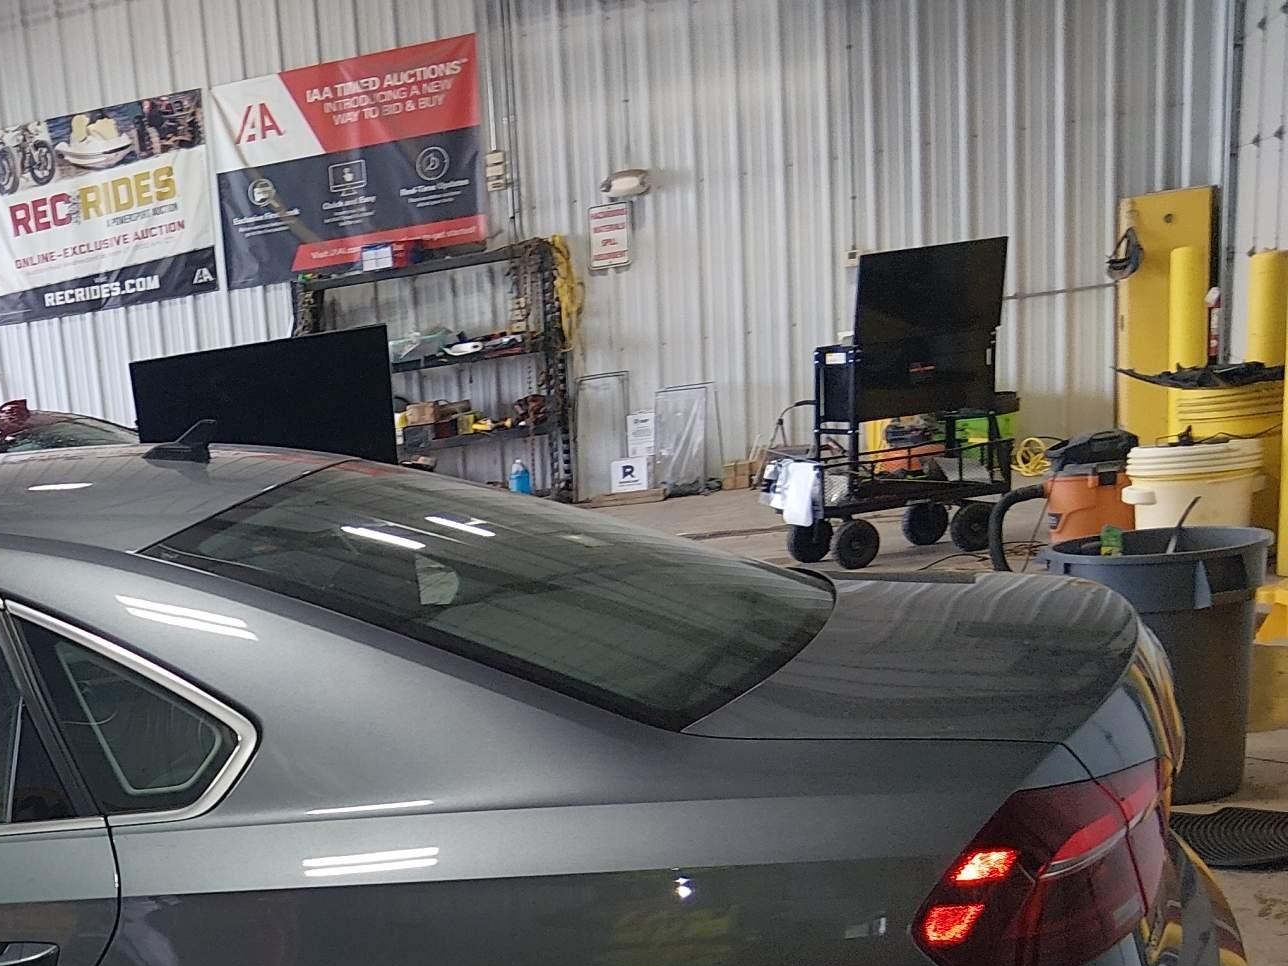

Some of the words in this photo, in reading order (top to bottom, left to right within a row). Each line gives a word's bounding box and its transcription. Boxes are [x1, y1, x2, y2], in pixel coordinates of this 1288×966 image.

[306, 87, 333, 103] IAA
[334, 77, 380, 97] TIMED
[324, 87, 408, 113] INTRODUCING
[410, 85, 421, 97] A
[422, 77, 455, 94] NEW
[332, 109, 361, 126] WAY
[362, 107, 379, 120] TO
[382, 103, 403, 116] BID
[405, 100, 417, 112] &
[418, 94, 447, 109] BUY
[9, 192, 74, 238] REC
[78, 165, 178, 221] RIDES
[15, 233, 130, 270] ONLINE-EXCLUSIVE
[133, 219, 186, 241] AUCTION
[44, 275, 161, 307] RECRIDES.COM
[621, 464, 635, 479] R
